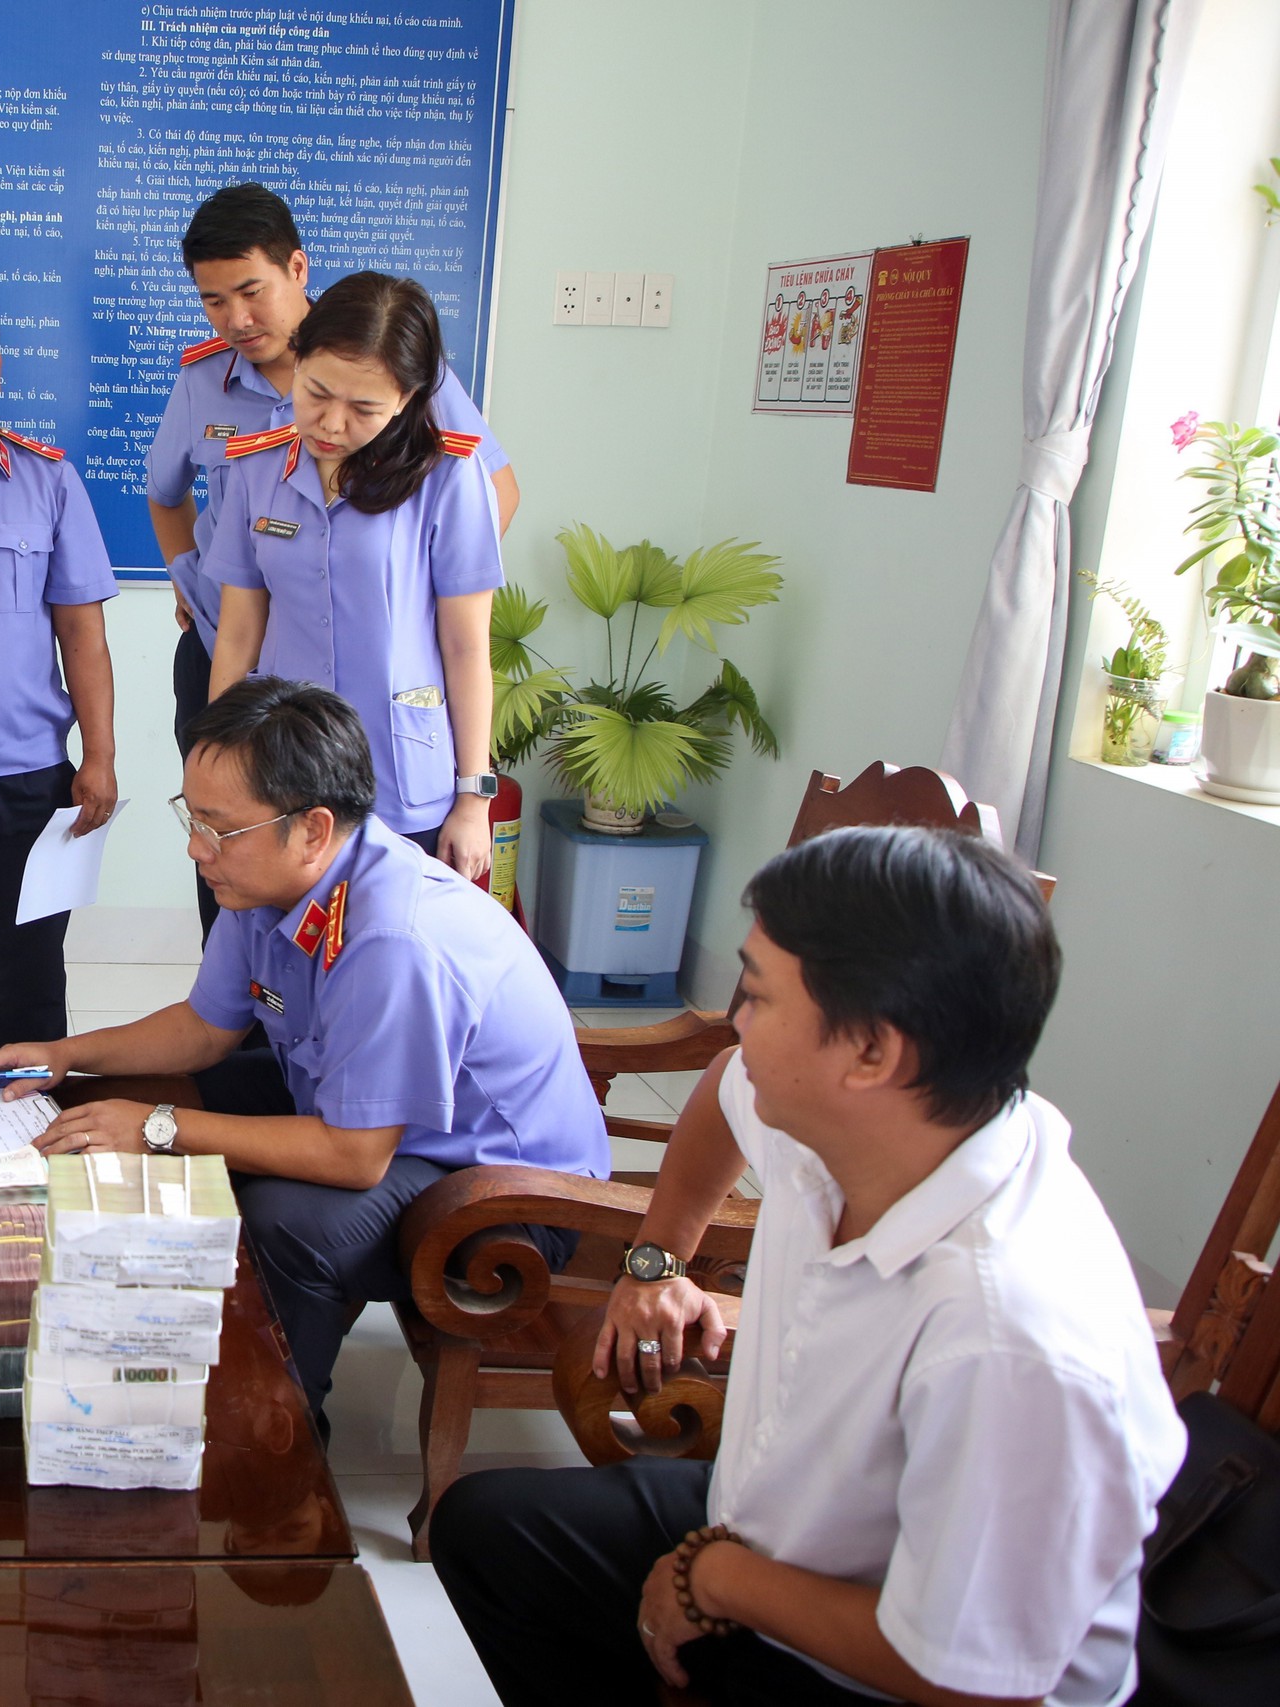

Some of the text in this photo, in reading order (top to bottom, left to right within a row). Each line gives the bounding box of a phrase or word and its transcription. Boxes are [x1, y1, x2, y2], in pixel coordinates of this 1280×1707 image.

[141, 20, 330, 40] III. Trách nhiệm của người tiếp công dân
[99, 114, 134, 125] vụ việc.
[20, 211, 43, 224] phản
[45, 211, 63, 222] ánh
[129, 325, 211, 343] IV. Những trường
[88, 398, 113, 409] mình;
[619, 898, 651, 910] Dustbin
